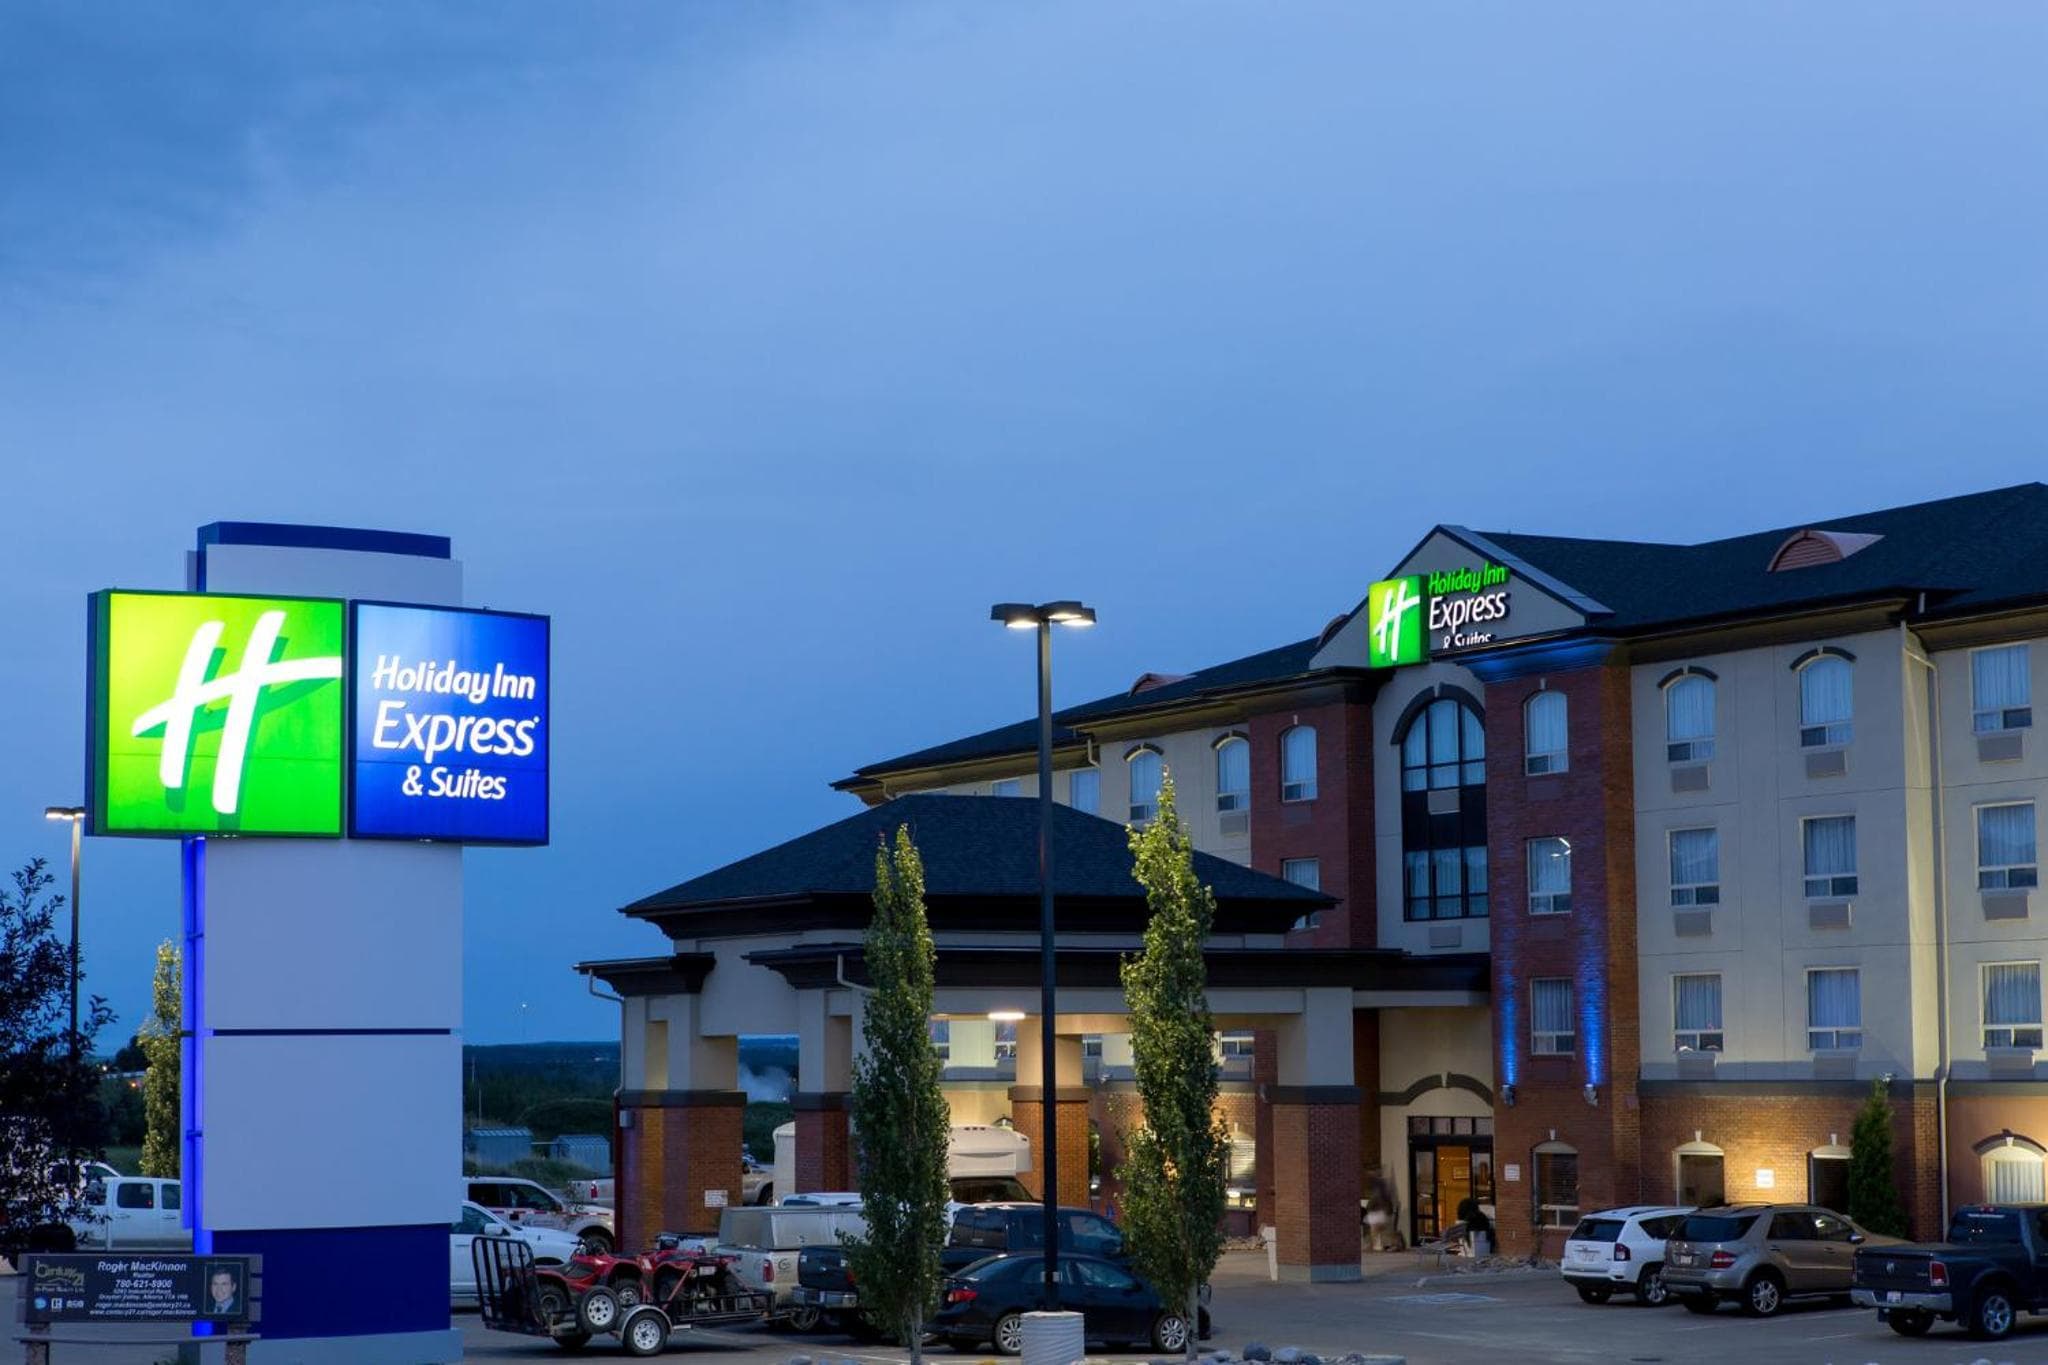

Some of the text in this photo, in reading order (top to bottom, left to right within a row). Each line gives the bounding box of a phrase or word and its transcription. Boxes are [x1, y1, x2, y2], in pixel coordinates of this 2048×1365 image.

[1428, 561, 1505, 595] Holiday Inn
[1429, 592, 1506, 634] Express
[372, 654, 536, 704] Holiday Inn
[372, 699, 540, 764] Express
[402, 765, 507, 800] & Suites
[97, 1261, 187, 1273] Roger MacKinnon
